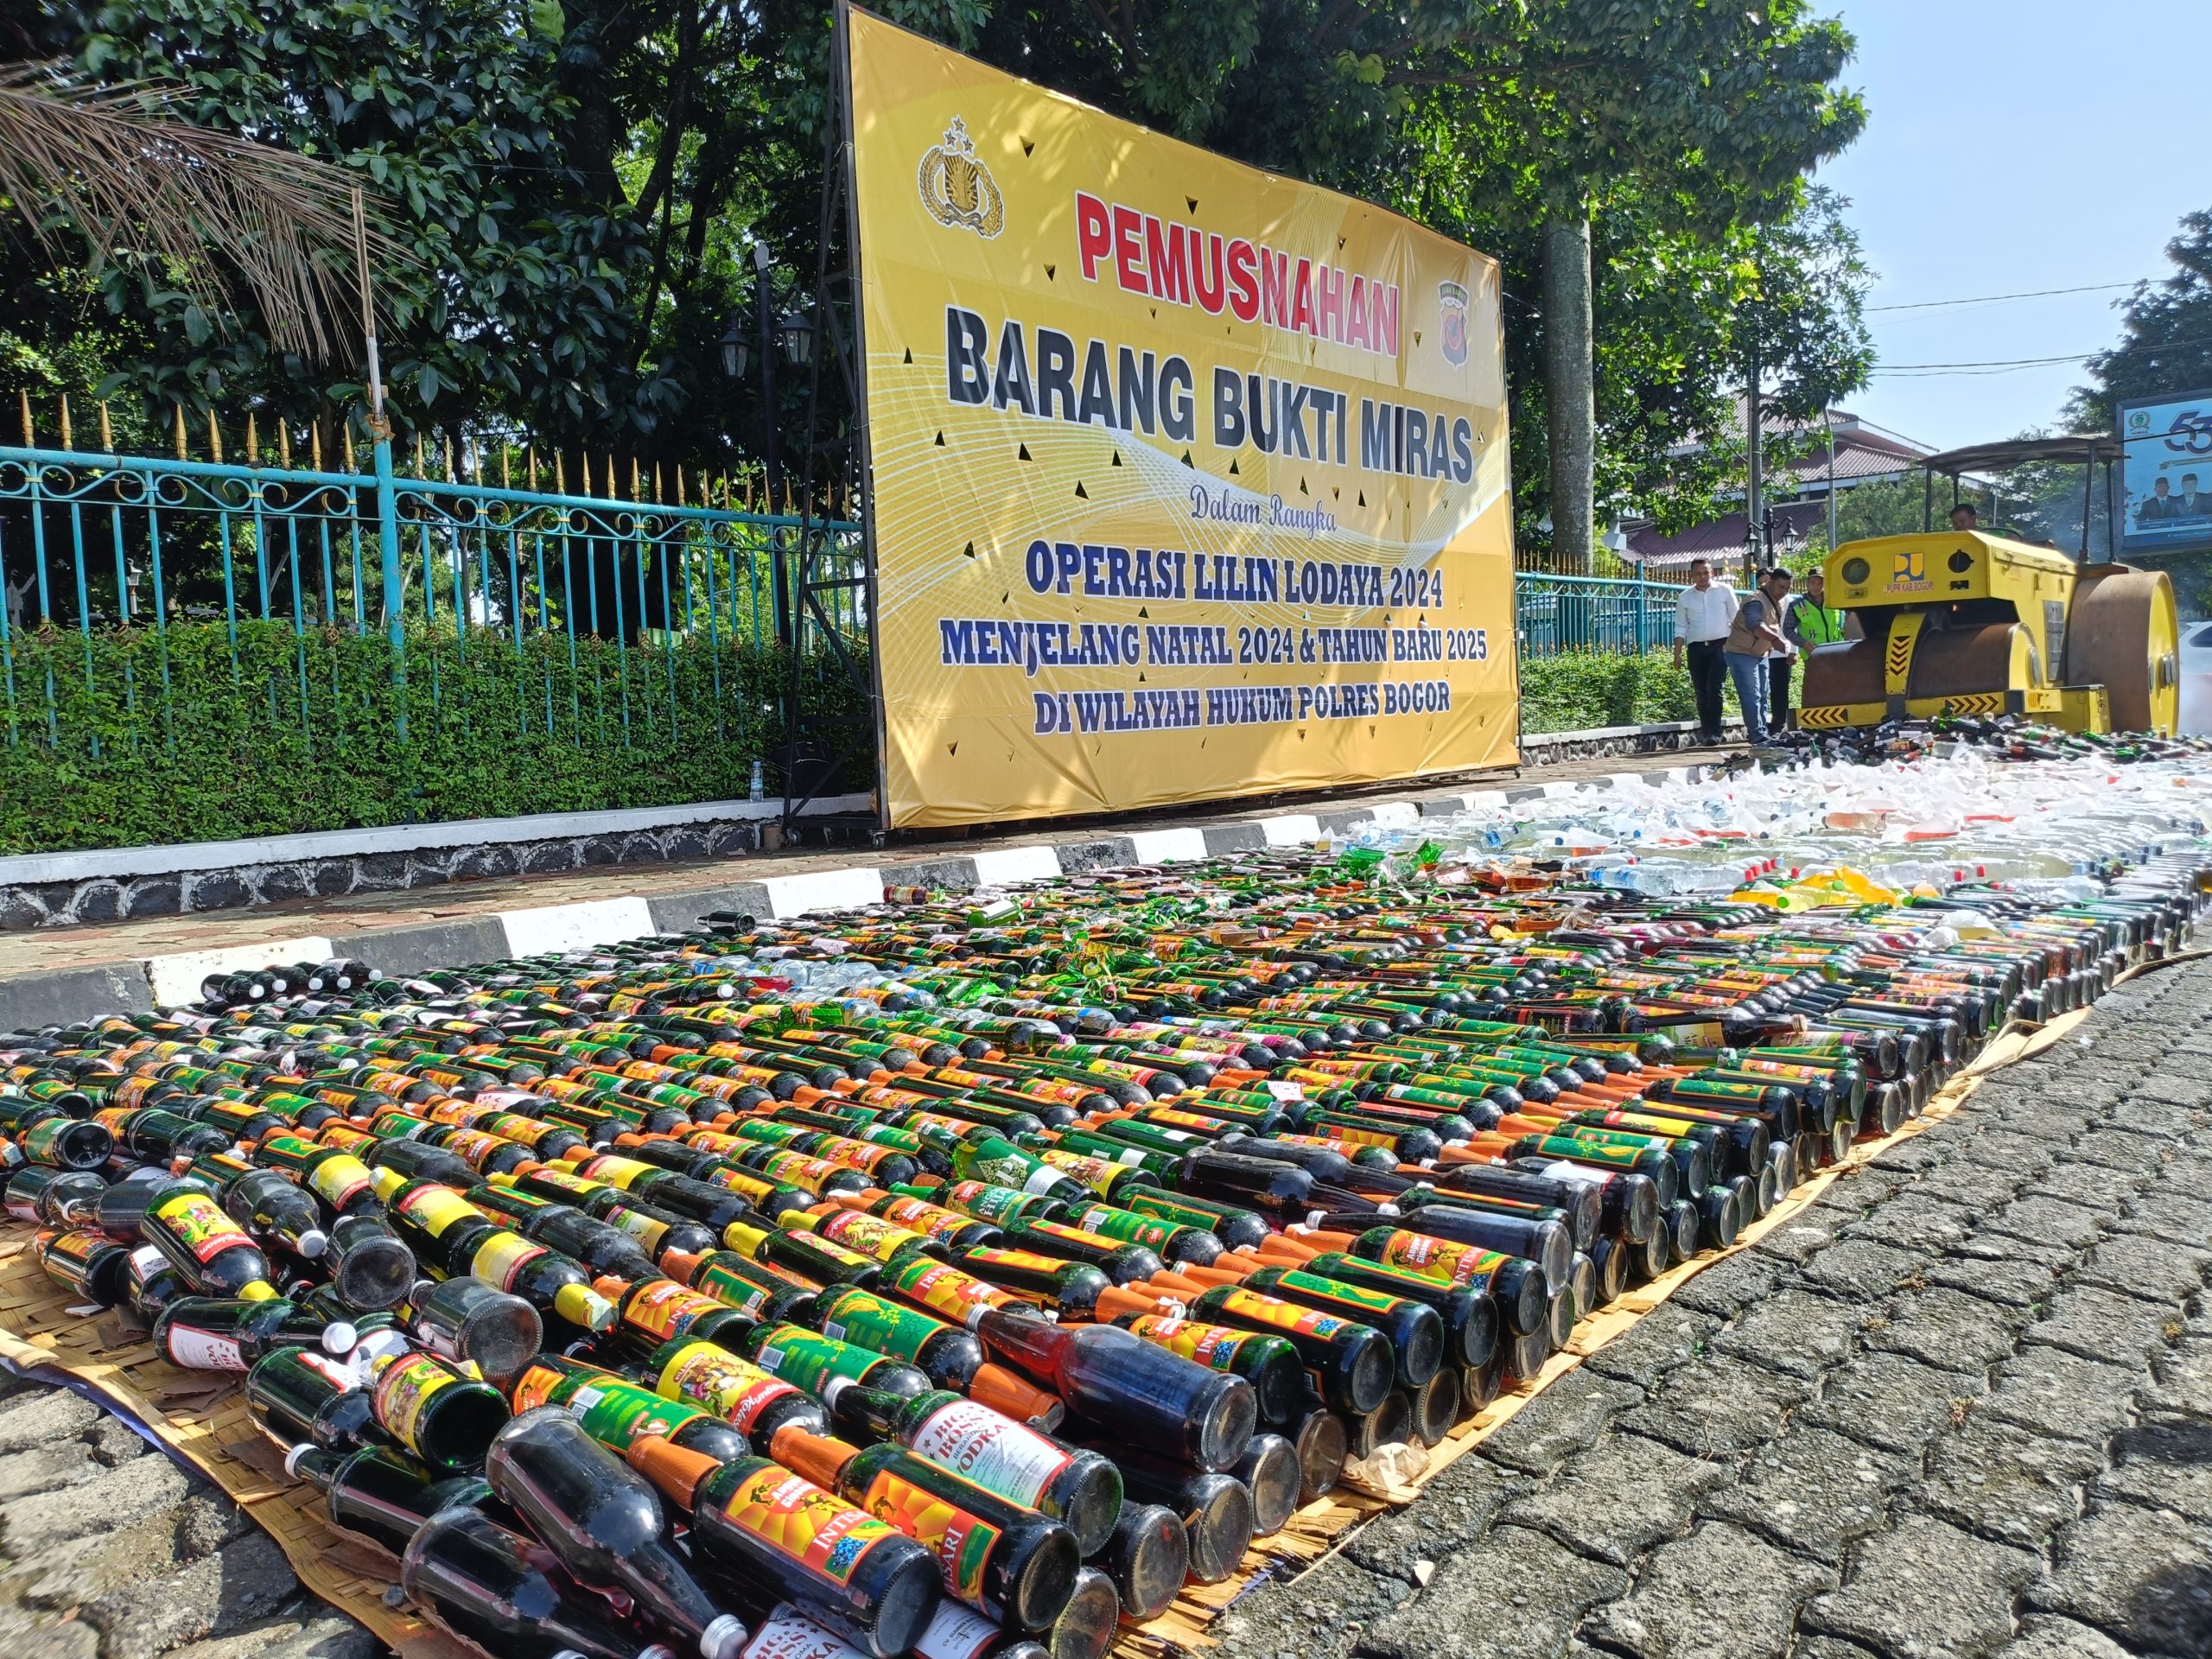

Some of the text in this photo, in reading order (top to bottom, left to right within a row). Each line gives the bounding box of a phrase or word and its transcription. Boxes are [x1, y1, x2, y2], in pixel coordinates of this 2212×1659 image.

[1077, 190, 1399, 358] PEMUSNAHAN
[947, 305, 1472, 483] BARANG BUKTI MIRAS
[1190, 485, 1338, 540] Dalam Rangka
[1026, 541, 1442, 608] OPERASI LILIN LODAYA 2024
[1884, 584, 1900, 594] PUPR
[940, 620, 1487, 677] MENJELANG NATAL 2024 & TAHUN BARU 2025
[1033, 680, 1451, 734] DI WILAYAH HUKUM POLRES BOGOR
[933, 1414, 964, 1440] BIG
[938, 1415, 984, 1459] BOSS
[812, 1510, 873, 1550] INTISA
